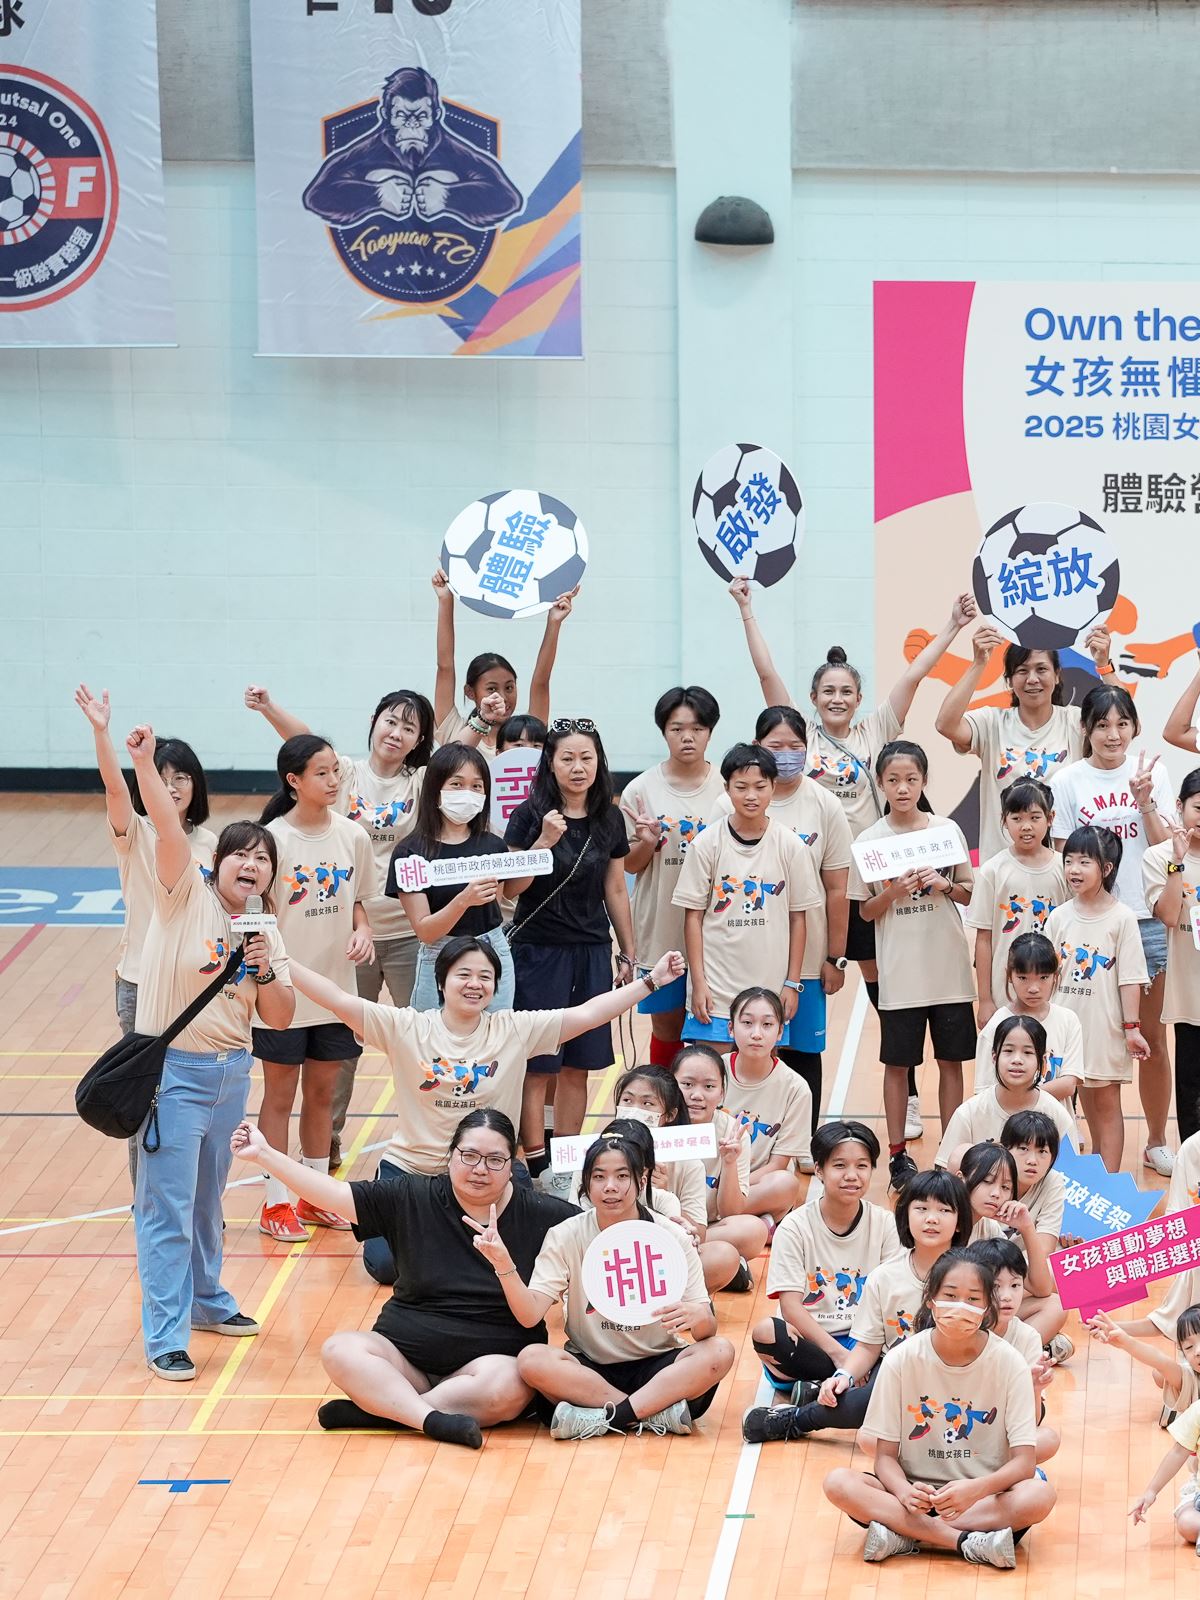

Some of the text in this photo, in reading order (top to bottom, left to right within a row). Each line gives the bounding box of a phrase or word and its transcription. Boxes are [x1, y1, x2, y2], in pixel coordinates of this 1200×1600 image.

[0, 91, 82, 149] utsal One
[65, 166, 97, 208] F
[349, 226, 431, 261] Taoyuan
[1024, 307, 1123, 342] Own
[1024, 414, 1105, 438] 2025
[478, 510, 552, 599] 體驗
[997, 547, 1099, 609] 綻放
[1092, 792, 1140, 812] MARA
[433, 852, 550, 876] 桃園市政府婦幼發展局
[727, 918, 766, 928] 桃園女孩日
[896, 903, 934, 916] 桃園女孩日
[434, 1100, 476, 1109] 桃園女孩日
[1060, 1217, 1189, 1277] 女孩運動夢想
[927, 1448, 971, 1459] 桃園女孩日
